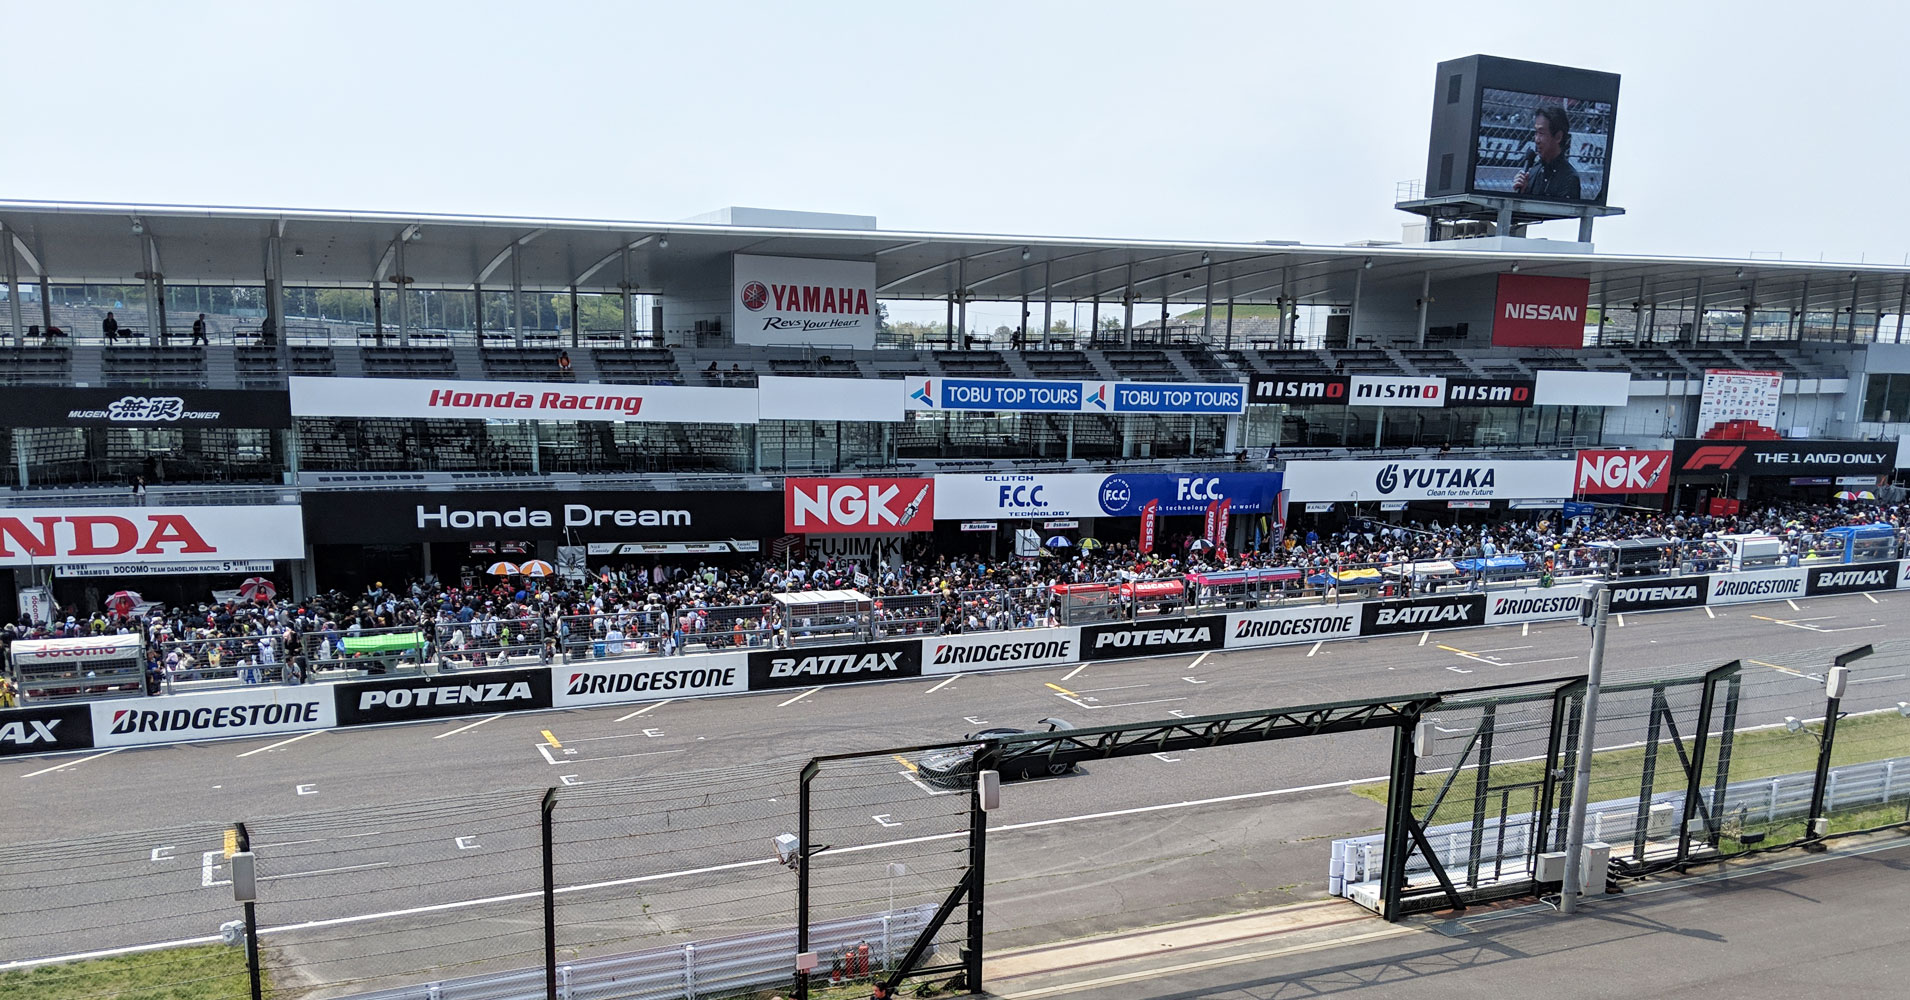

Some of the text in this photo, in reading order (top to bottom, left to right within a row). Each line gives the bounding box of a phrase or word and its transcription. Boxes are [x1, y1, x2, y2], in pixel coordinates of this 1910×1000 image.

[771, 284, 869, 315] YAMAHA
[1505, 303, 1577, 321] NISSAN
[763, 316, 802, 330] Revs
[802, 319, 831, 331] Your
[947, 385, 1079, 405] TOBU TOP TOURS
[1119, 388, 1239, 408] TOBU TOP TOURS
[1256, 381, 1344, 399] nismo
[1357, 383, 1438, 400] nismo
[1451, 385, 1528, 402] nismo
[67, 396, 220, 421] MUGEN 無限 POWER
[429, 389, 643, 416] Honda Racing
[1754, 453, 1789, 464] THE
[1790, 454, 1800, 463] 1
[1803, 454, 1840, 464] AND
[1842, 454, 1886, 464] ONLY
[1403, 468, 1495, 488] YUTAKA
[1580, 455, 1650, 488] NGK
[999, 485, 1048, 507] F.C.C.
[1106, 489, 1128, 501] F.C.C.
[1177, 477, 1224, 501] F.C.C.
[416, 504, 691, 527] Honda Dream
[794, 484, 900, 527] NGK
[1165, 504, 1207, 512] technology
[1145, 505, 1155, 549] VESSEL
[58, 566, 64, 575] 1
[113, 566, 149, 574] DOCOMO
[223, 562, 230, 571] 5
[1137, 582, 1173, 590] DUCATI
[1714, 578, 1802, 597] BRIDGESTONE
[1818, 570, 1889, 587] BATTLAX
[1613, 585, 1698, 602] POTENZA
[1376, 604, 1472, 625] BATTLAX
[1493, 597, 1581, 616] BRIDGESTO
[1095, 626, 1211, 648] POTENZA
[1235, 615, 1354, 639] BRIDGESTONE
[35, 644, 116, 658] docomo
[932, 640, 1071, 665] BRIDGESTONE
[769, 651, 903, 678] BATTLAX
[566, 667, 736, 696] BRIDGESTONE
[359, 677, 533, 710] POTENZA
[110, 701, 320, 735] BRIDGESTONE
